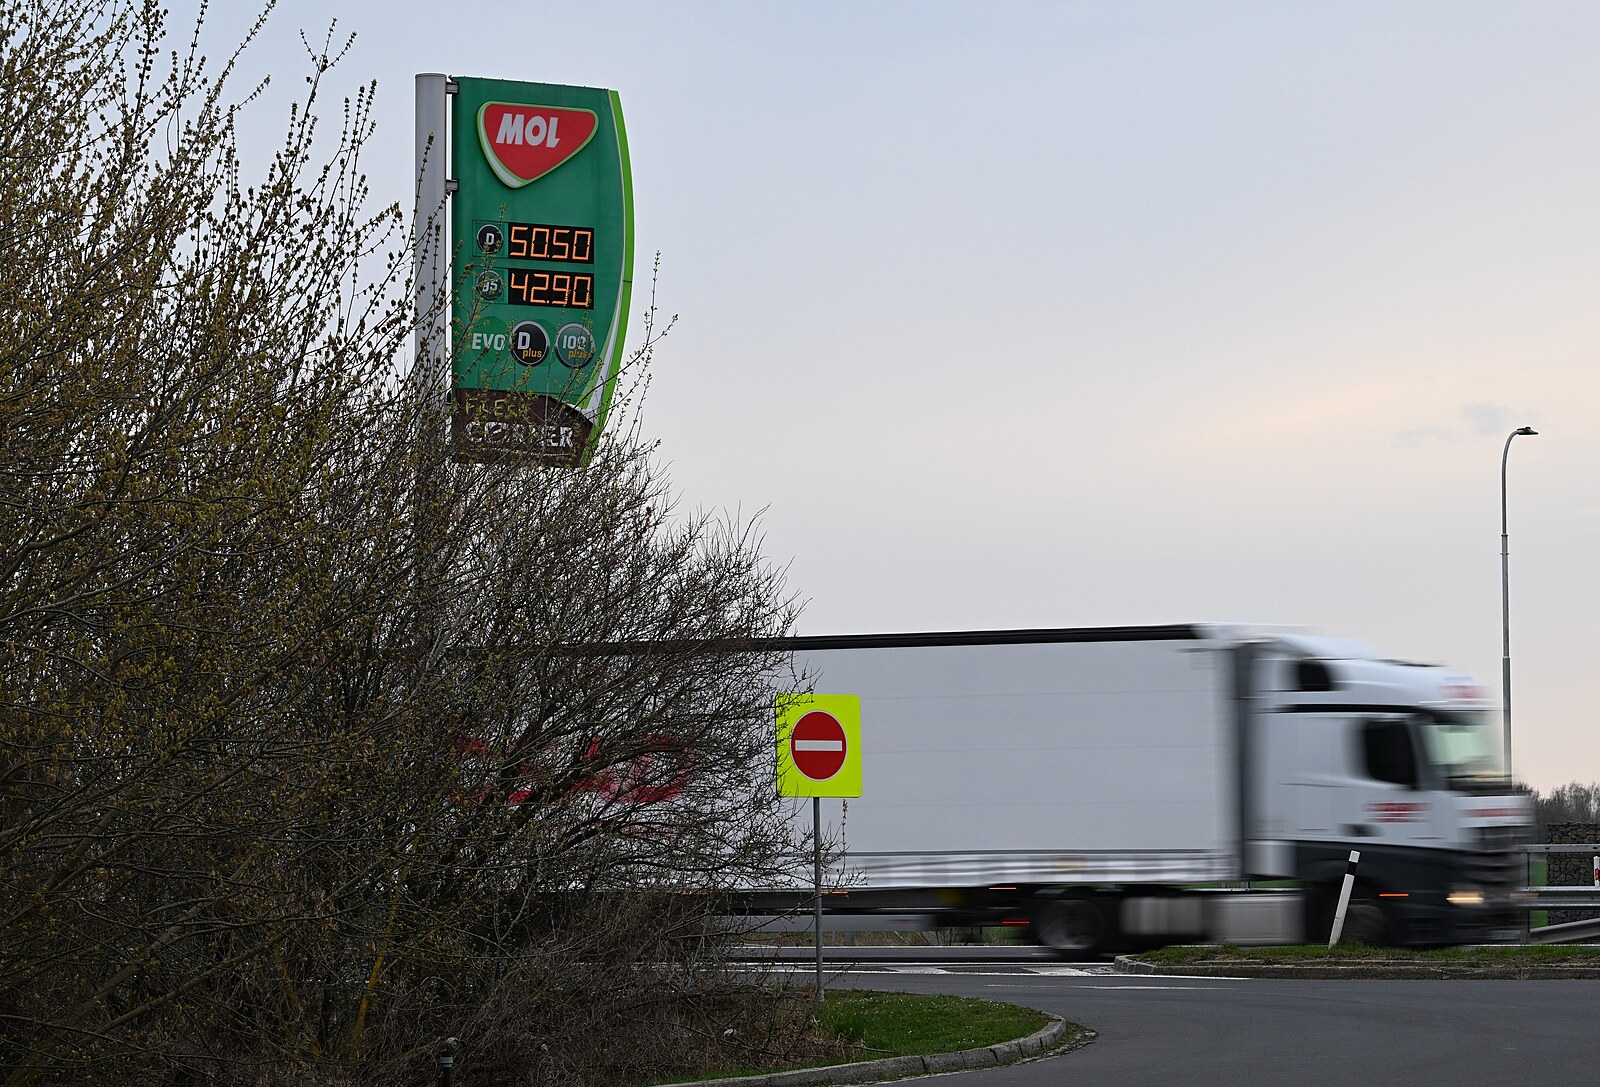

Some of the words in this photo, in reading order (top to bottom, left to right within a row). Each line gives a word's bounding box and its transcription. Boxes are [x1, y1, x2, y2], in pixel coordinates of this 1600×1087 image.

[496, 113, 560, 147] MOL
[486, 233, 495, 245] D
[510, 226, 591, 260] 50.50
[510, 273, 591, 306] 42.90
[472, 333, 506, 351] EVO
[517, 331, 531, 350] D
[522, 348, 543, 360] plus
[465, 397, 530, 418] FRE
